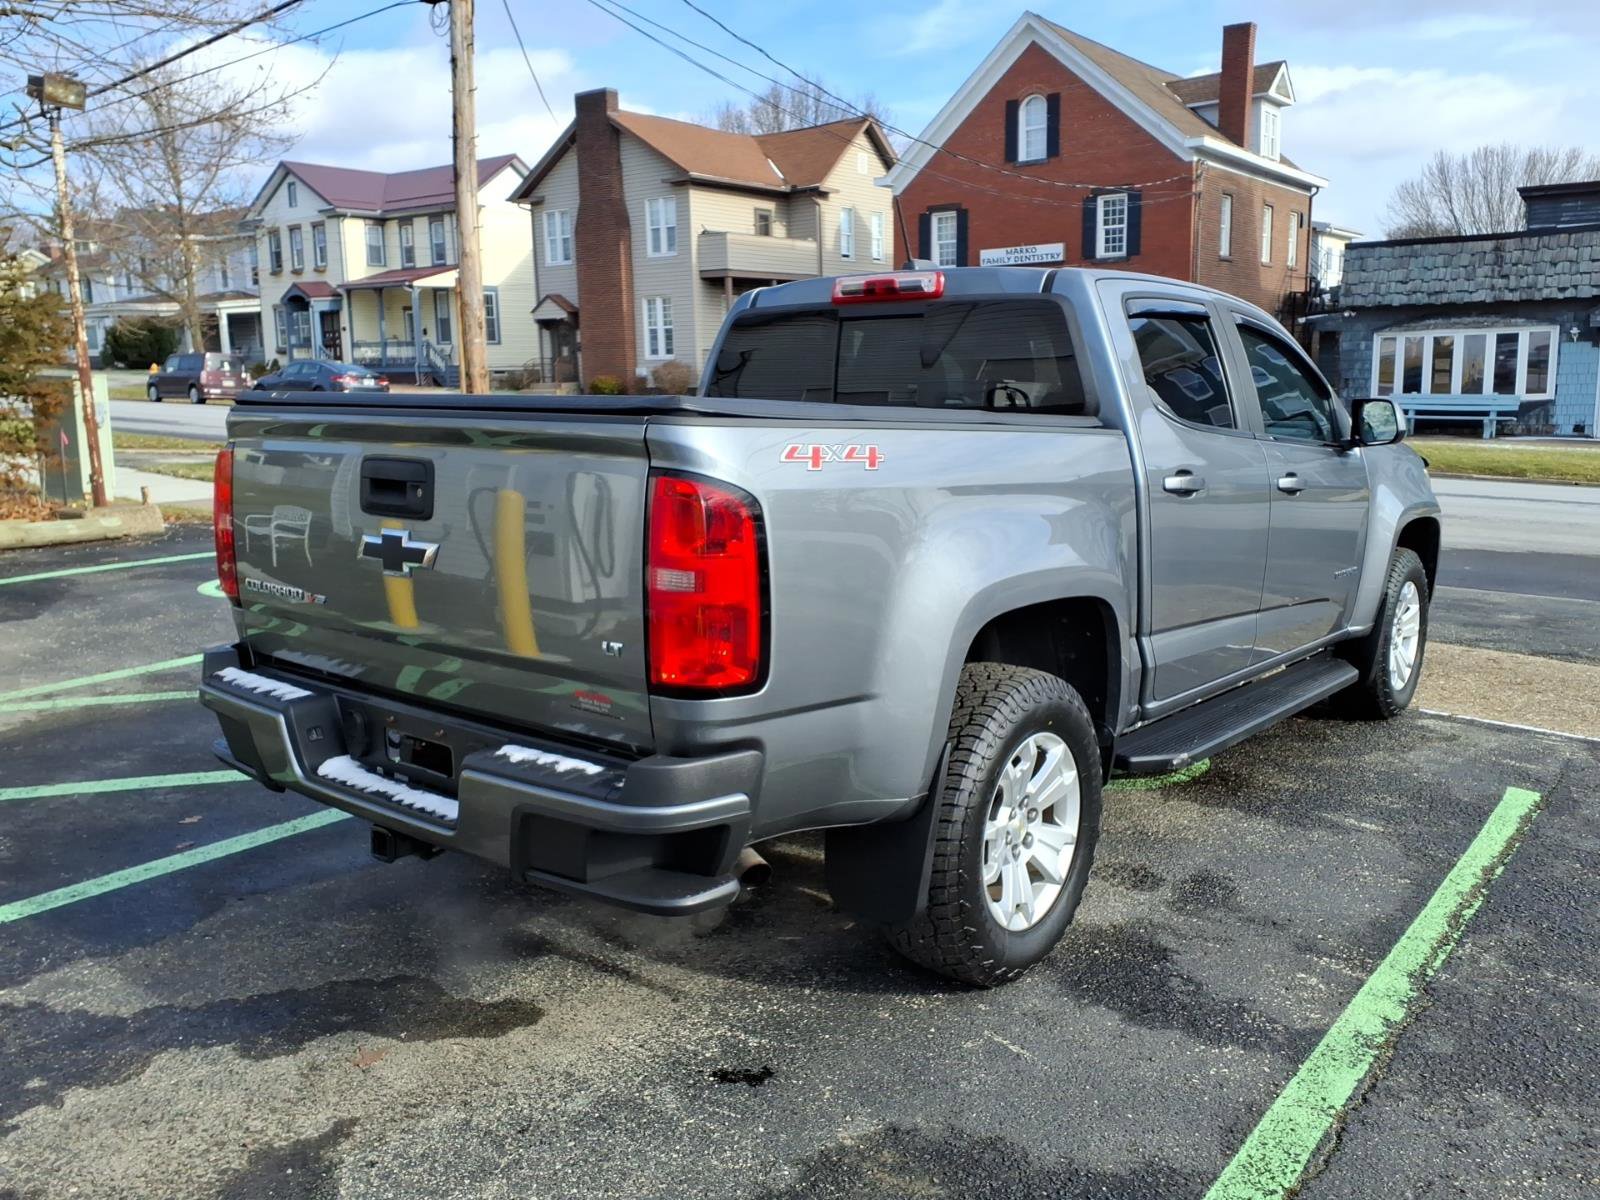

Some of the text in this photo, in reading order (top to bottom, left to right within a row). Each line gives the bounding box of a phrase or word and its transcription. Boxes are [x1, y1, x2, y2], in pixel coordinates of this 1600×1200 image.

[982, 252, 1062, 265] FAMILY DENTISTRY
[1005, 246, 1038, 256] MARKO
[245, 577, 305, 601] COLORADO
[601, 640, 624, 657] LT
